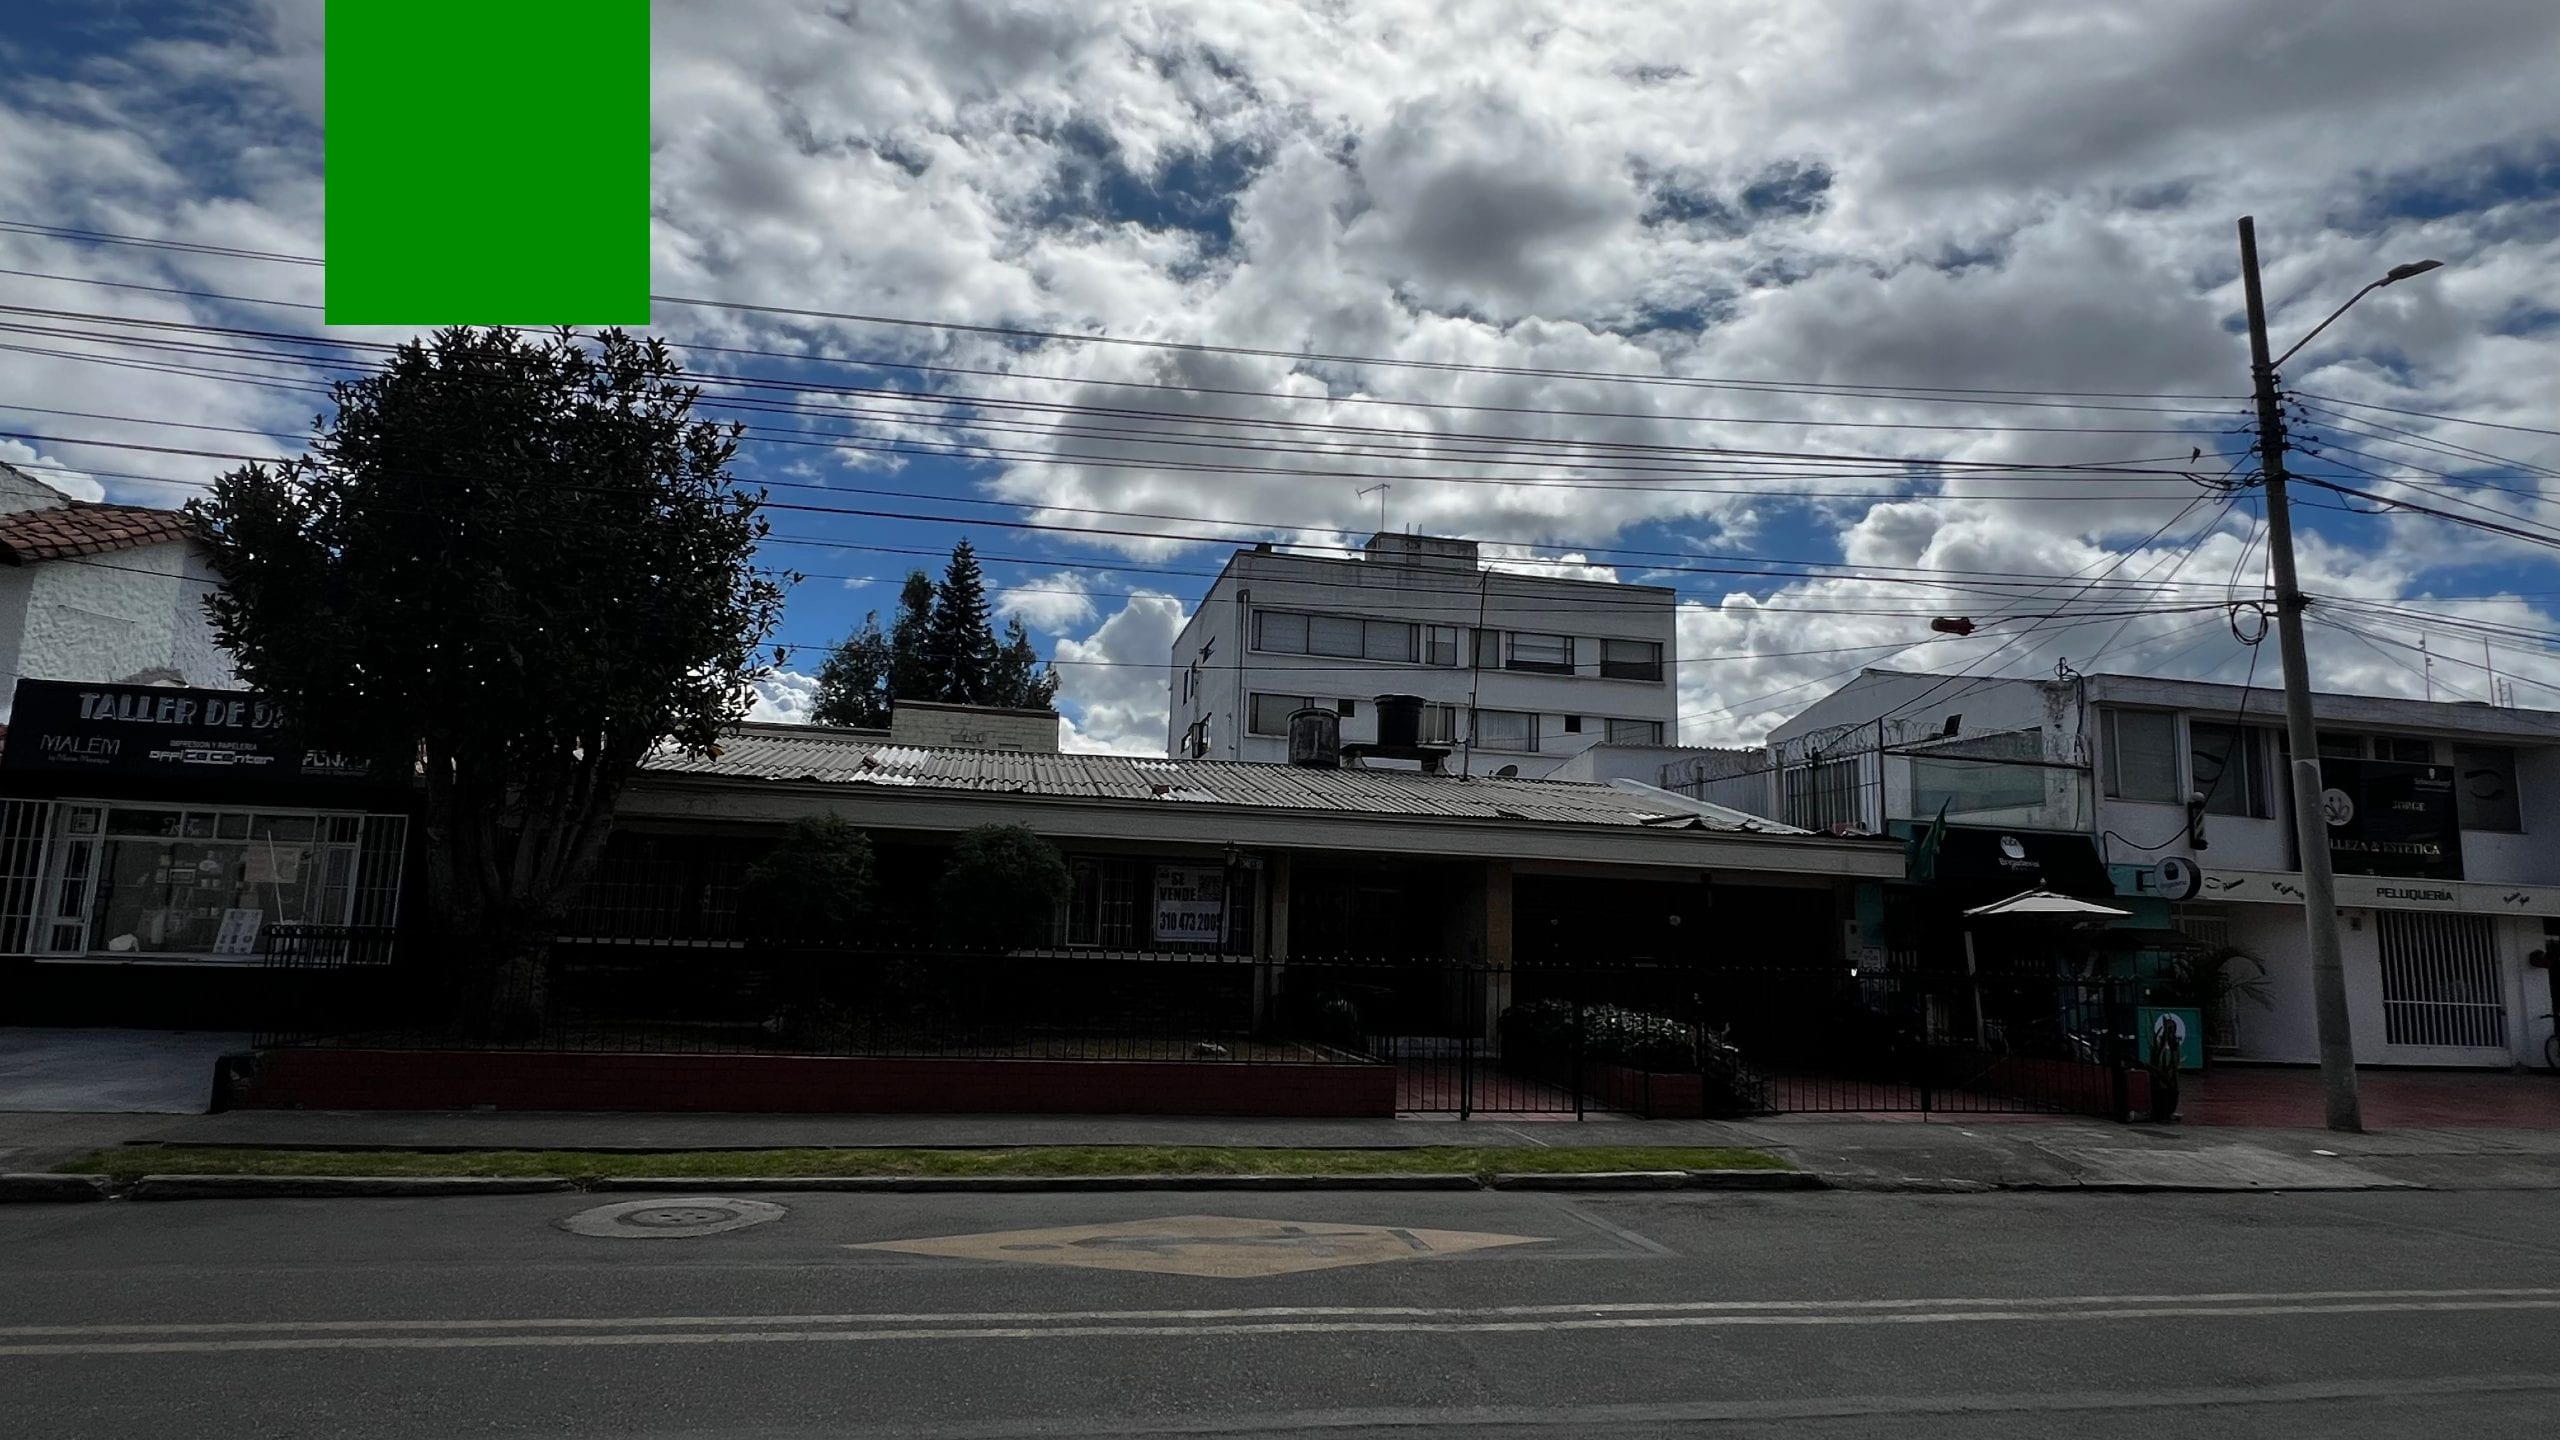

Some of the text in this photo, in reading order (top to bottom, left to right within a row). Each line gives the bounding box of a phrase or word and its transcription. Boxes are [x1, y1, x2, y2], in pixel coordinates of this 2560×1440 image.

[79, 692, 198, 725] TALLER
[204, 699, 246, 727] DE
[2330, 839, 2368, 852] LLEZA
[1160, 887, 1197, 901] VENDE
[1179, 913, 1196, 931] 473
